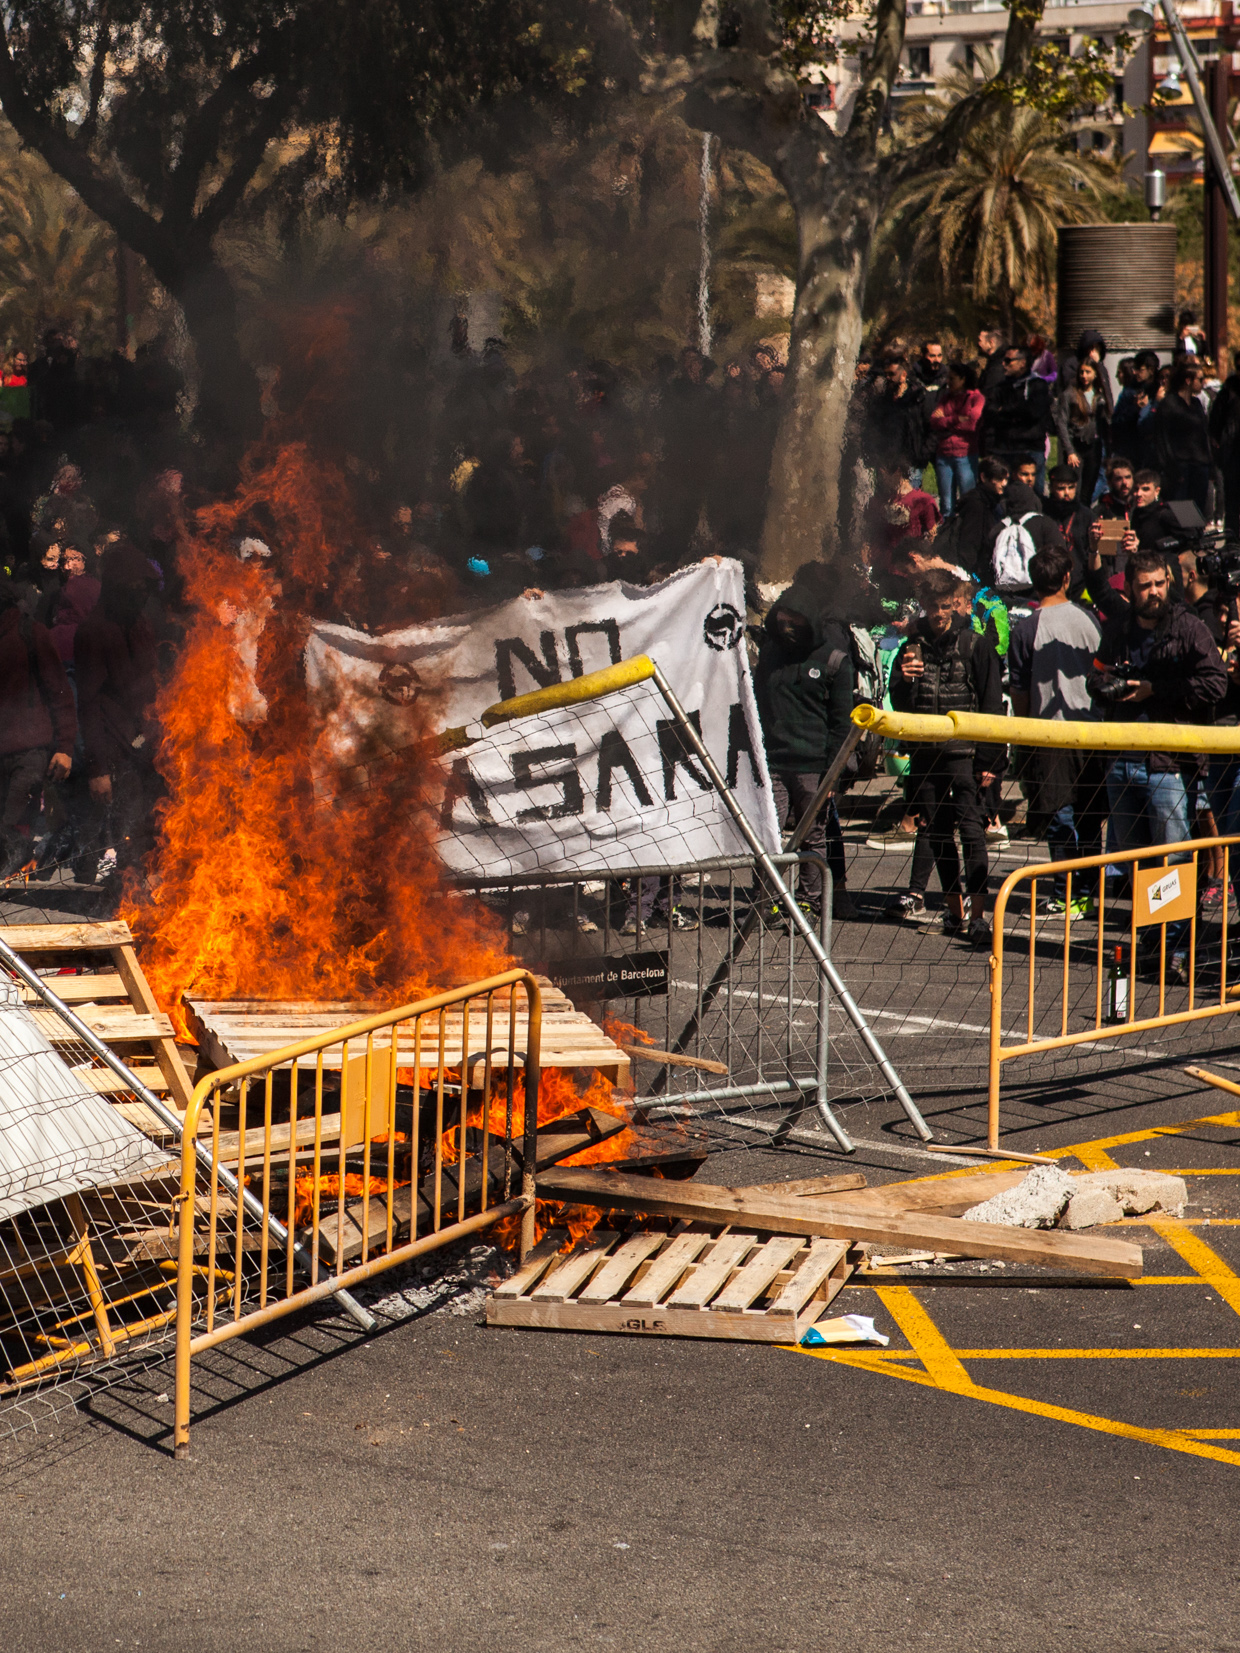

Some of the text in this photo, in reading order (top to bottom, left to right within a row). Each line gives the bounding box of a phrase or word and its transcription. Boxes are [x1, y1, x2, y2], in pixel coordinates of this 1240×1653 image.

[493, 617, 622, 701] NO
[1162, 878, 1177, 893] GRUAS
[553, 967, 665, 988] Ajuntament de Barcelona
